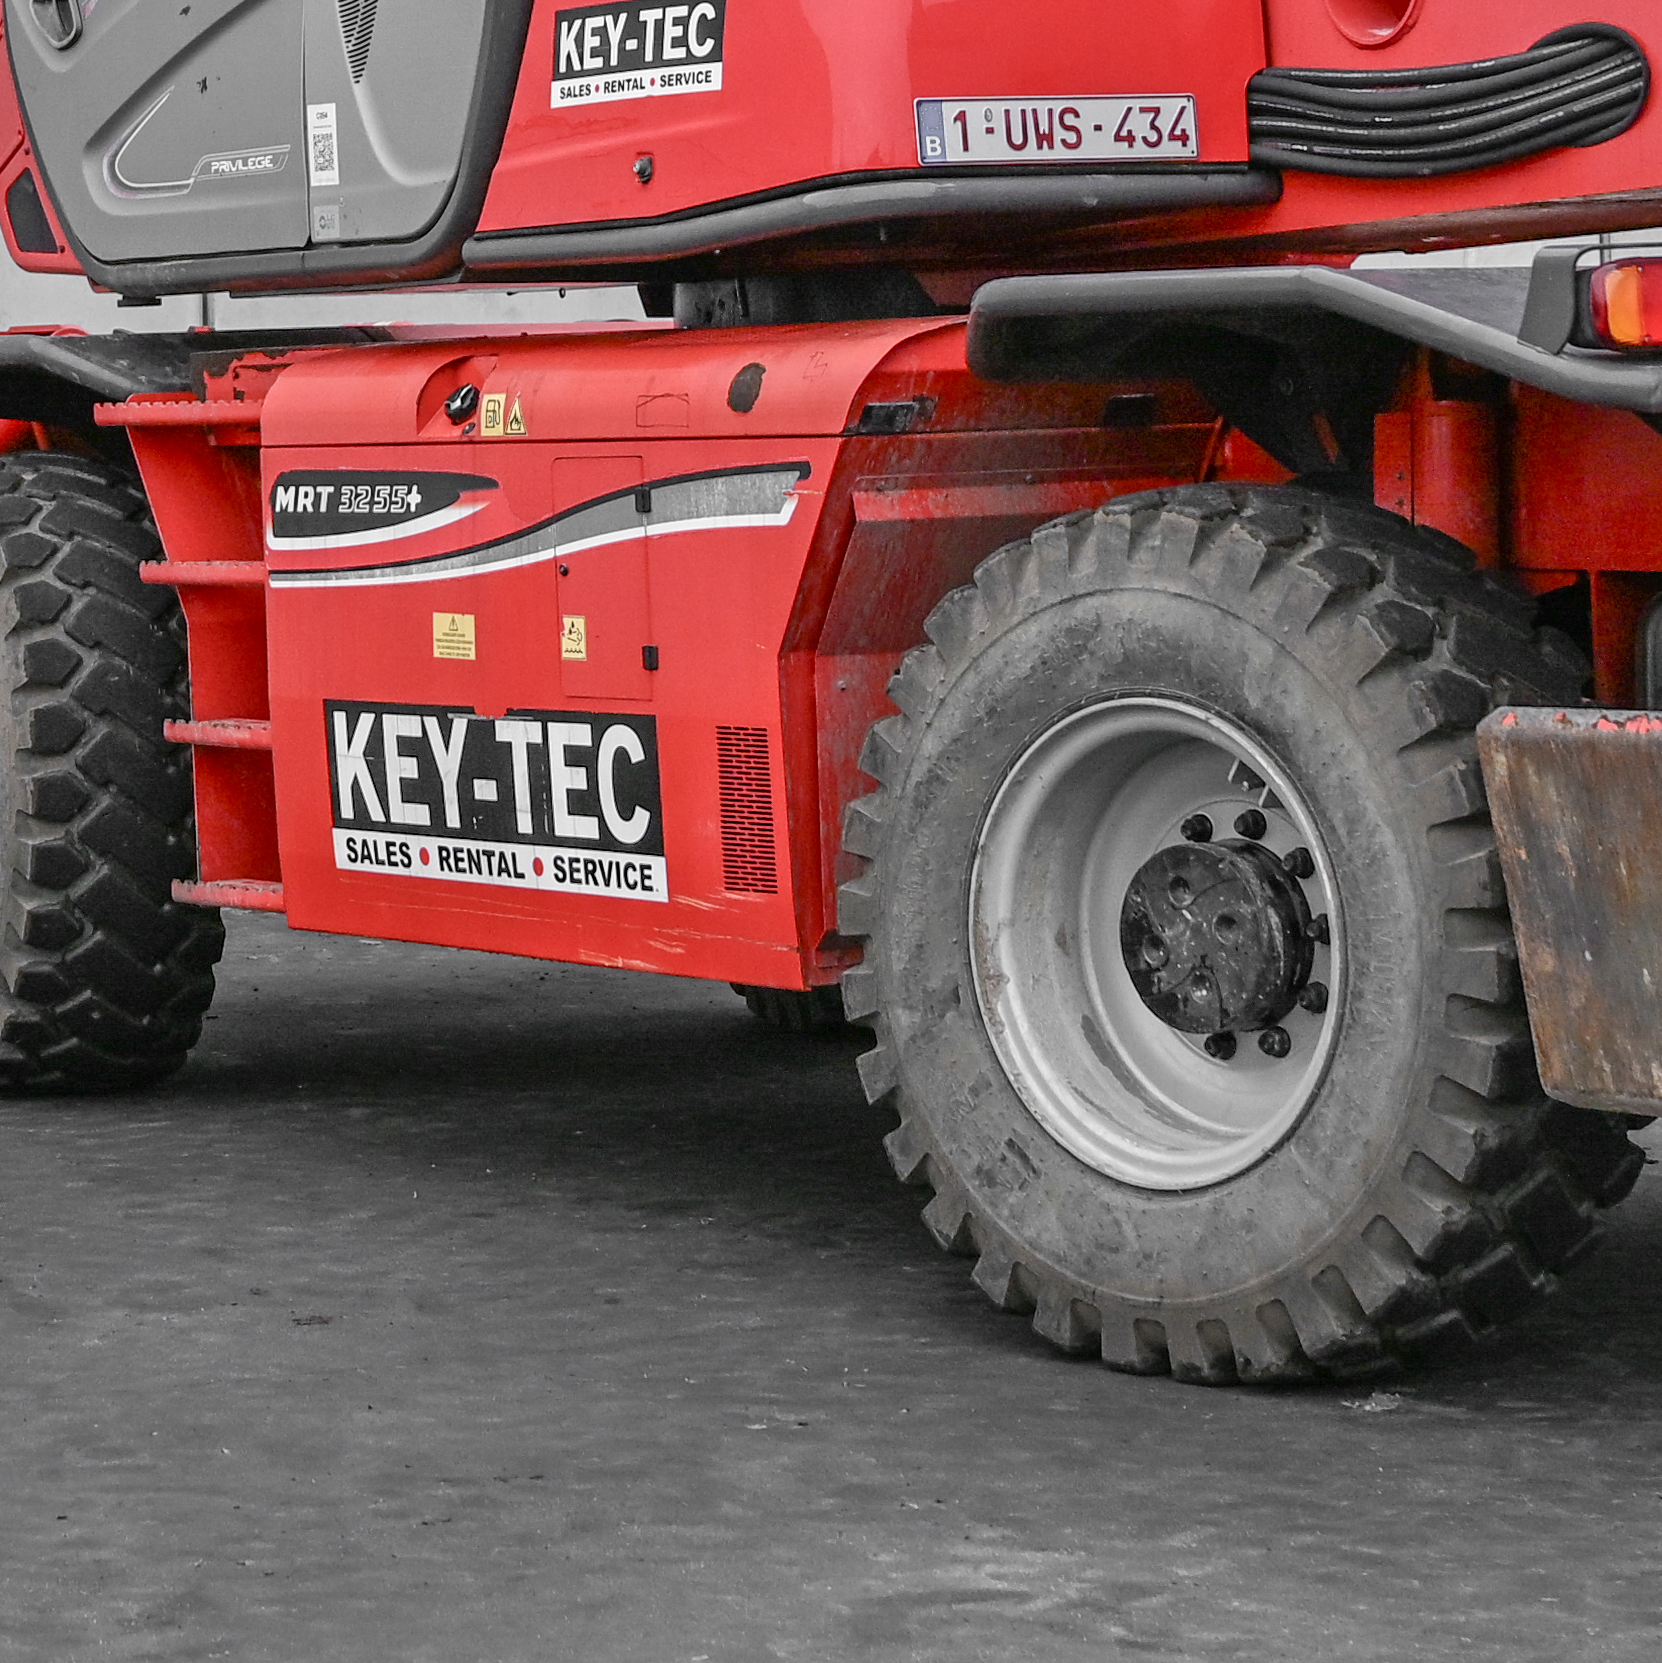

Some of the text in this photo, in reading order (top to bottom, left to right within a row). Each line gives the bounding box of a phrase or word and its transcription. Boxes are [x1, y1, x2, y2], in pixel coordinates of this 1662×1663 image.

[558, 1, 716, 73] KEY-TEC
[559, 70, 712, 100] SALES RENTAL SERVICE
[925, 136, 943, 157] B
[211, 155, 274, 174] PRIVILEGE
[275, 484, 422, 513] MRT 3255+
[333, 711, 651, 845] KEY-TEC
[346, 837, 655, 892] SALES RENTAL SERVICE
